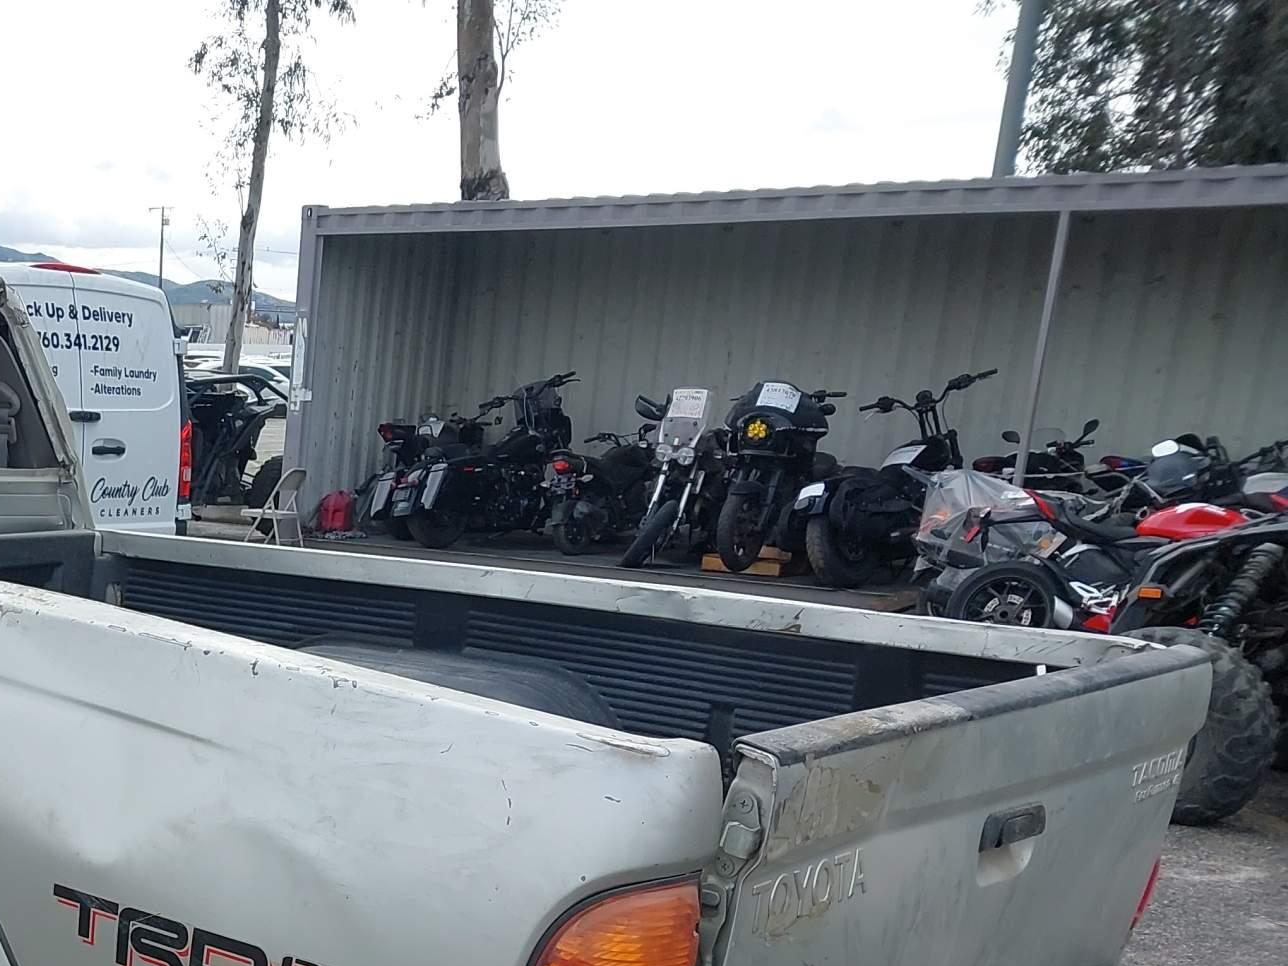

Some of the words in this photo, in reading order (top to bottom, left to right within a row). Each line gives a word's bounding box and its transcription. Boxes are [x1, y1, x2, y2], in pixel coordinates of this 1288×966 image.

[27, 301, 43, 317] ck
[45, 302, 64, 322] Up
[69, 304, 78, 320] &
[82, 305, 133, 328] Delivery
[90, 365, 122, 380] -Family
[124, 367, 157, 383] Laundry
[90, 383, 142, 397] -Alterations
[90, 477, 138, 506] Country
[142, 476, 169, 501] Club
[100, 506, 160, 517] CLEANERS
[752, 847, 866, 937] TOYOTA
